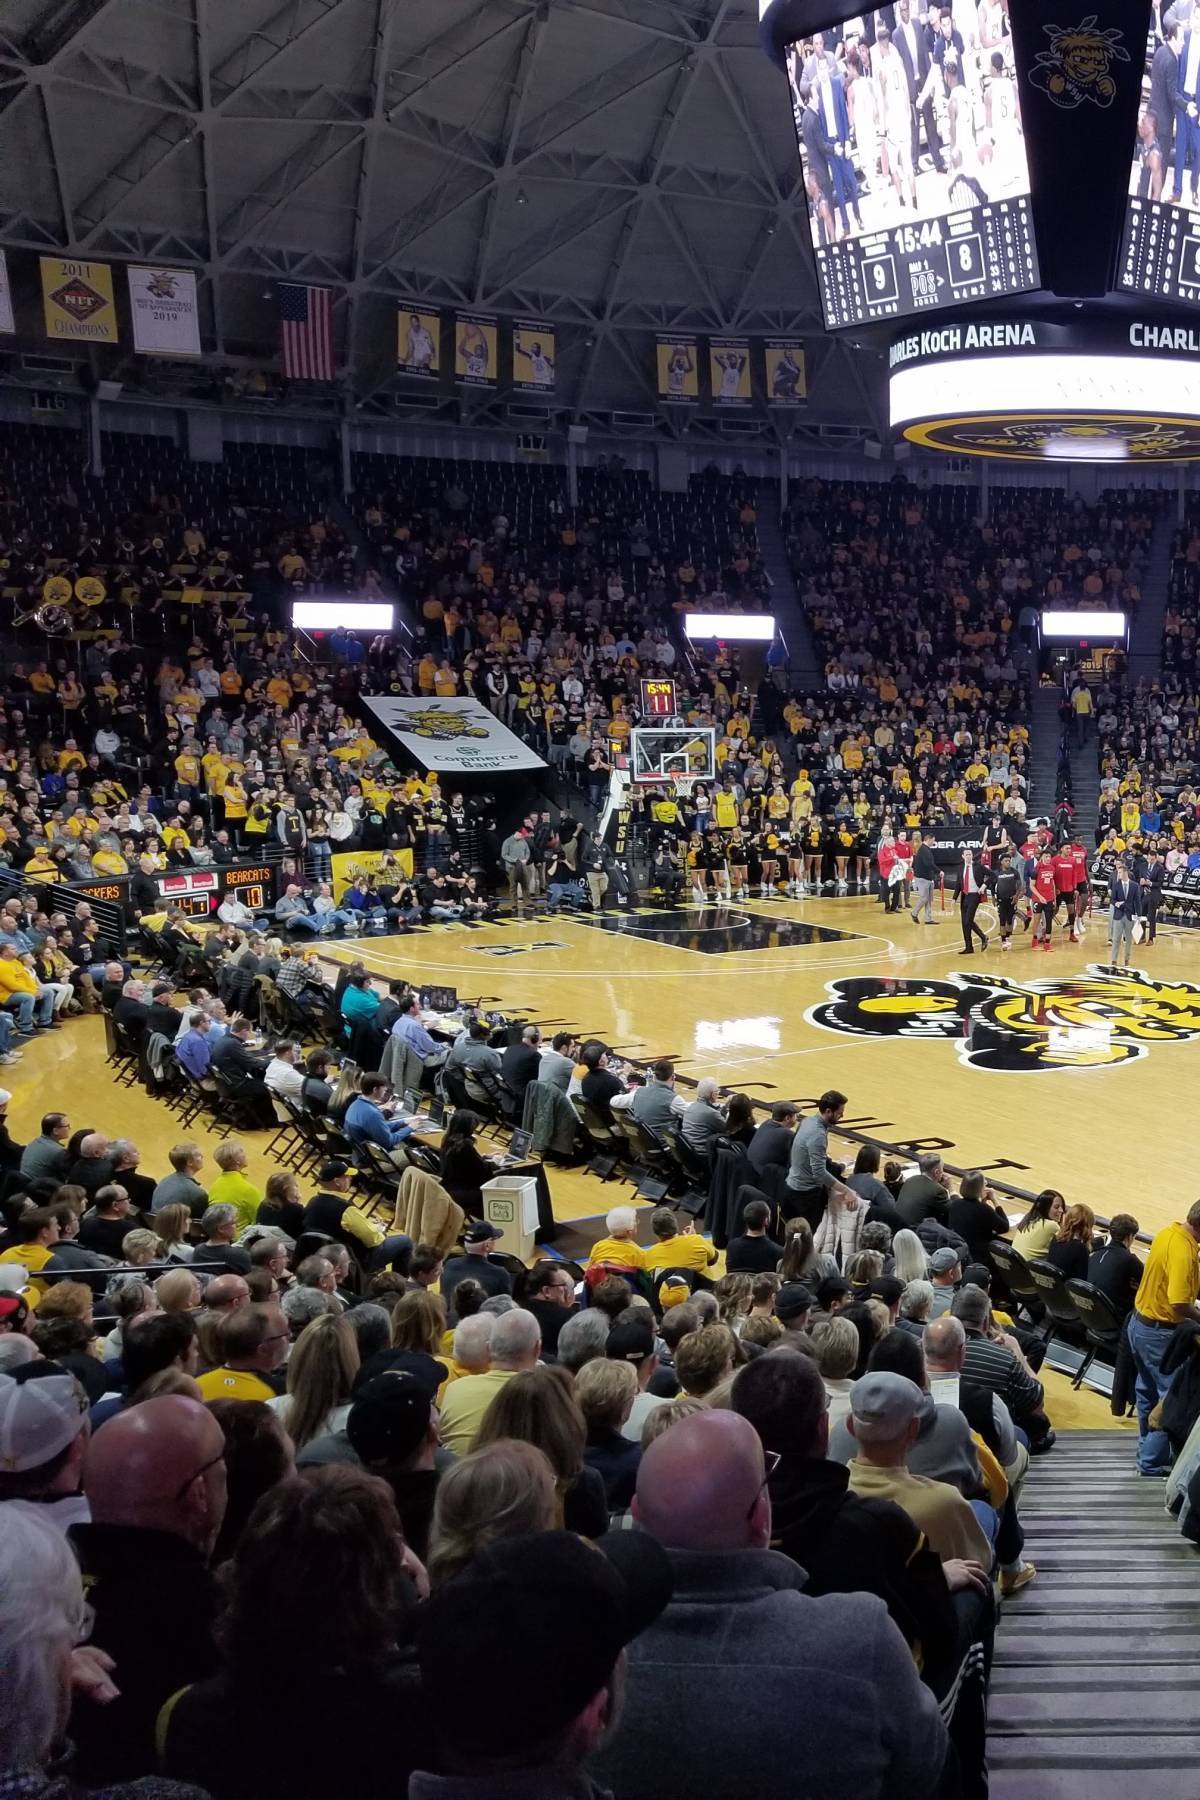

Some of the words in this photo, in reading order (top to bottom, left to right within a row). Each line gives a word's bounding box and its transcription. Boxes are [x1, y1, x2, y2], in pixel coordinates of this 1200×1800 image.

[894, 220, 942, 254] 15:44
[959, 244, 972, 271] 8
[61, 263, 91, 279] 2011
[873, 264, 886, 290] 9
[911, 273, 937, 296] POS
[979, 283, 985, 295] 2
[153, 312, 178, 322] 2019
[54, 319, 109, 337] CHAMPIONS
[920, 327, 960, 355] KOCH
[965, 324, 1036, 349] ARENA
[518, 434, 545, 450] 117
[647, 683, 671, 695] 15:44
[654, 695, 668, 712] 11
[433, 754, 519, 763] Commerce
[615, 811, 631, 853] WSU
[930, 841, 955, 849] DER
[226, 867, 271, 885] BEARCATS
[246, 888, 261, 906] 10
